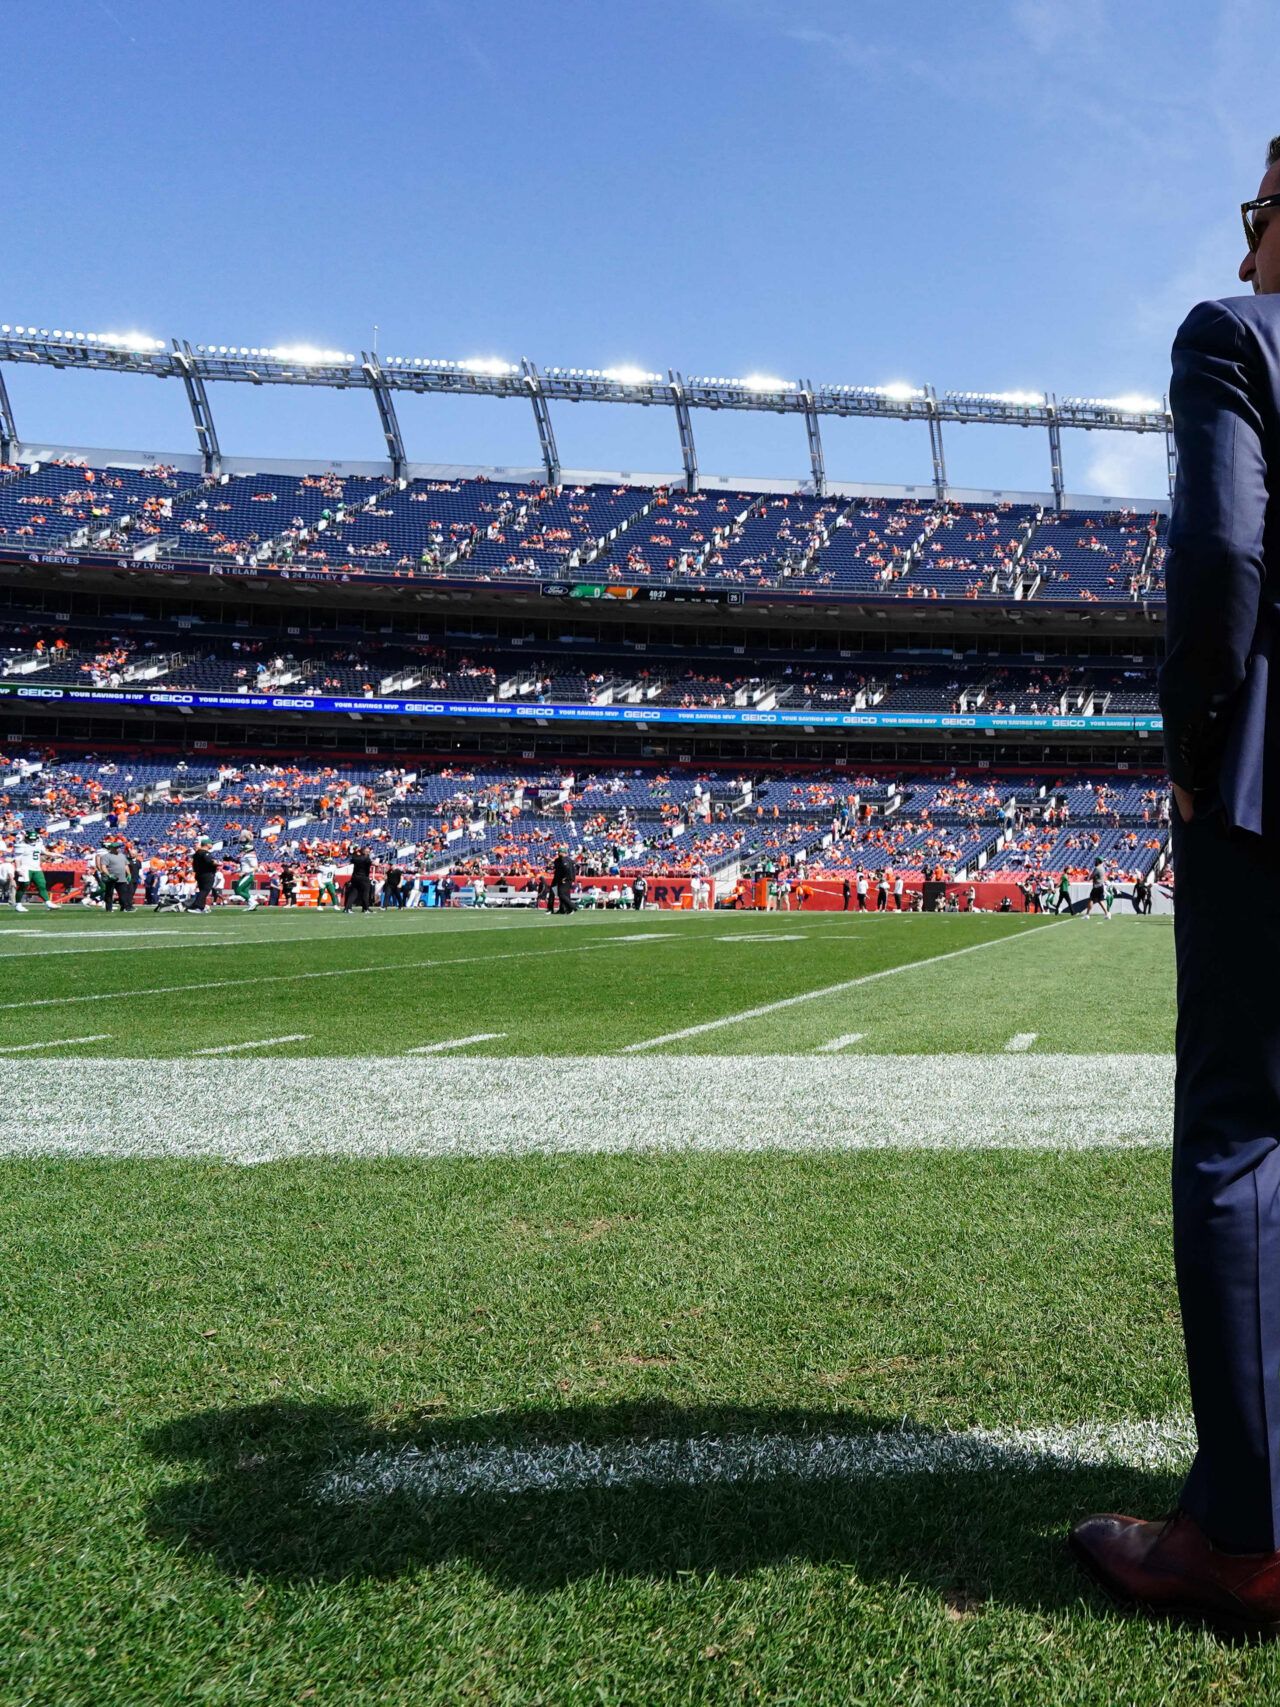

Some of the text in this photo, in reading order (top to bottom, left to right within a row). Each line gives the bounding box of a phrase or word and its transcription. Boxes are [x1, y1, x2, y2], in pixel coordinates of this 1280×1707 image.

[41, 555, 80, 565] REEVES
[144, 562, 175, 571] LYNCH
[232, 568, 258, 576] ELAM
[305, 573, 338, 581] BAILEY
[594, 588, 600, 598] 0
[626, 588, 633, 600] 0
[17, 687, 64, 698] GEICO
[92, 692, 124, 700] SAVINGS
[150, 693, 193, 703] GEICO
[219, 697, 250, 705] SAVINGS
[273, 698, 314, 708] GEICO
[334, 701, 353, 709] YOUR
[354, 702, 383, 710] SAVINGS
[405, 703, 444, 713] GEICO
[516, 707, 554, 716] GEICO
[624, 710, 661, 719] GEICO
[741, 714, 777, 722] GEICO
[842, 716, 877, 724] GEICO
[941, 718, 976, 726] GEICO
[1052, 719, 1086, 727] GEICO
[32, 850, 40, 860] 5
